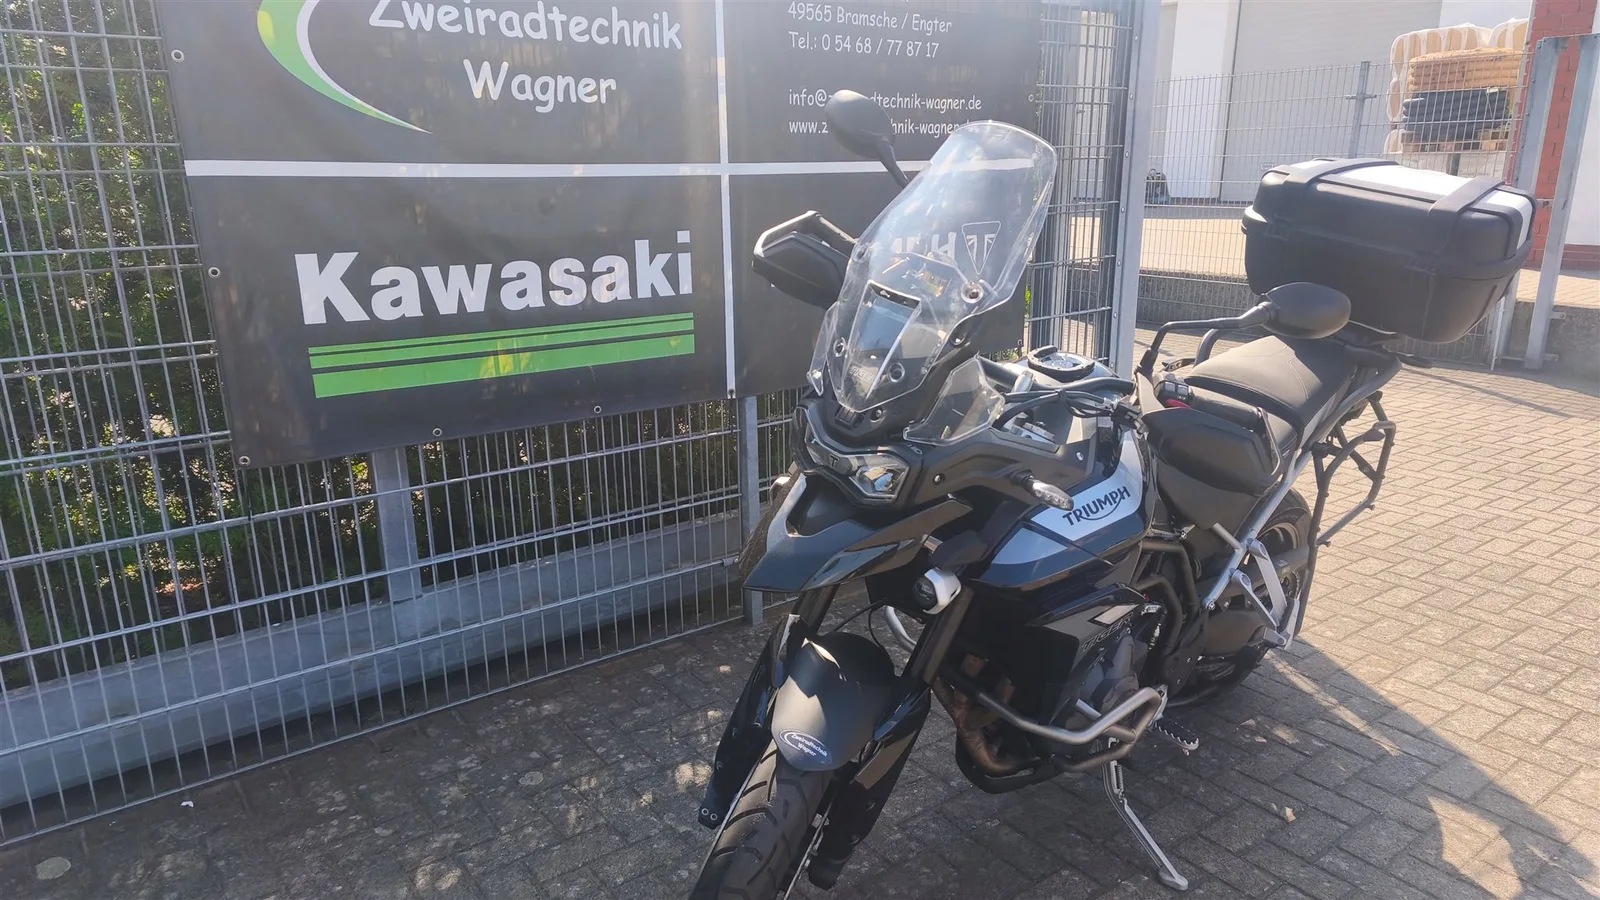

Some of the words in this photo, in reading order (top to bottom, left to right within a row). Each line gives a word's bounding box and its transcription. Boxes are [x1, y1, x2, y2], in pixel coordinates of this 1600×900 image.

[369, 0, 683, 49] Zweiradtechnik
[788, 1, 832, 22] 49565
[837, 6, 898, 28] Bramsche
[901, 12, 909, 29] /
[912, 13, 952, 36] Engter
[788, 31, 817, 50] Tel.:
[822, 34, 831, 51] 0
[834, 35, 851, 52] 54
[856, 37, 872, 54] 68
[876, 38, 883, 54] /
[887, 39, 902, 56] 77
[906, 40, 922, 57] 87
[925, 42, 939, 58] 17
[463, 59, 617, 113] Wagner
[295, 230, 693, 325] Kawasaki
[1062, 485, 1131, 526] TRIUMPH
[797, 742, 817, 757] Wagner
